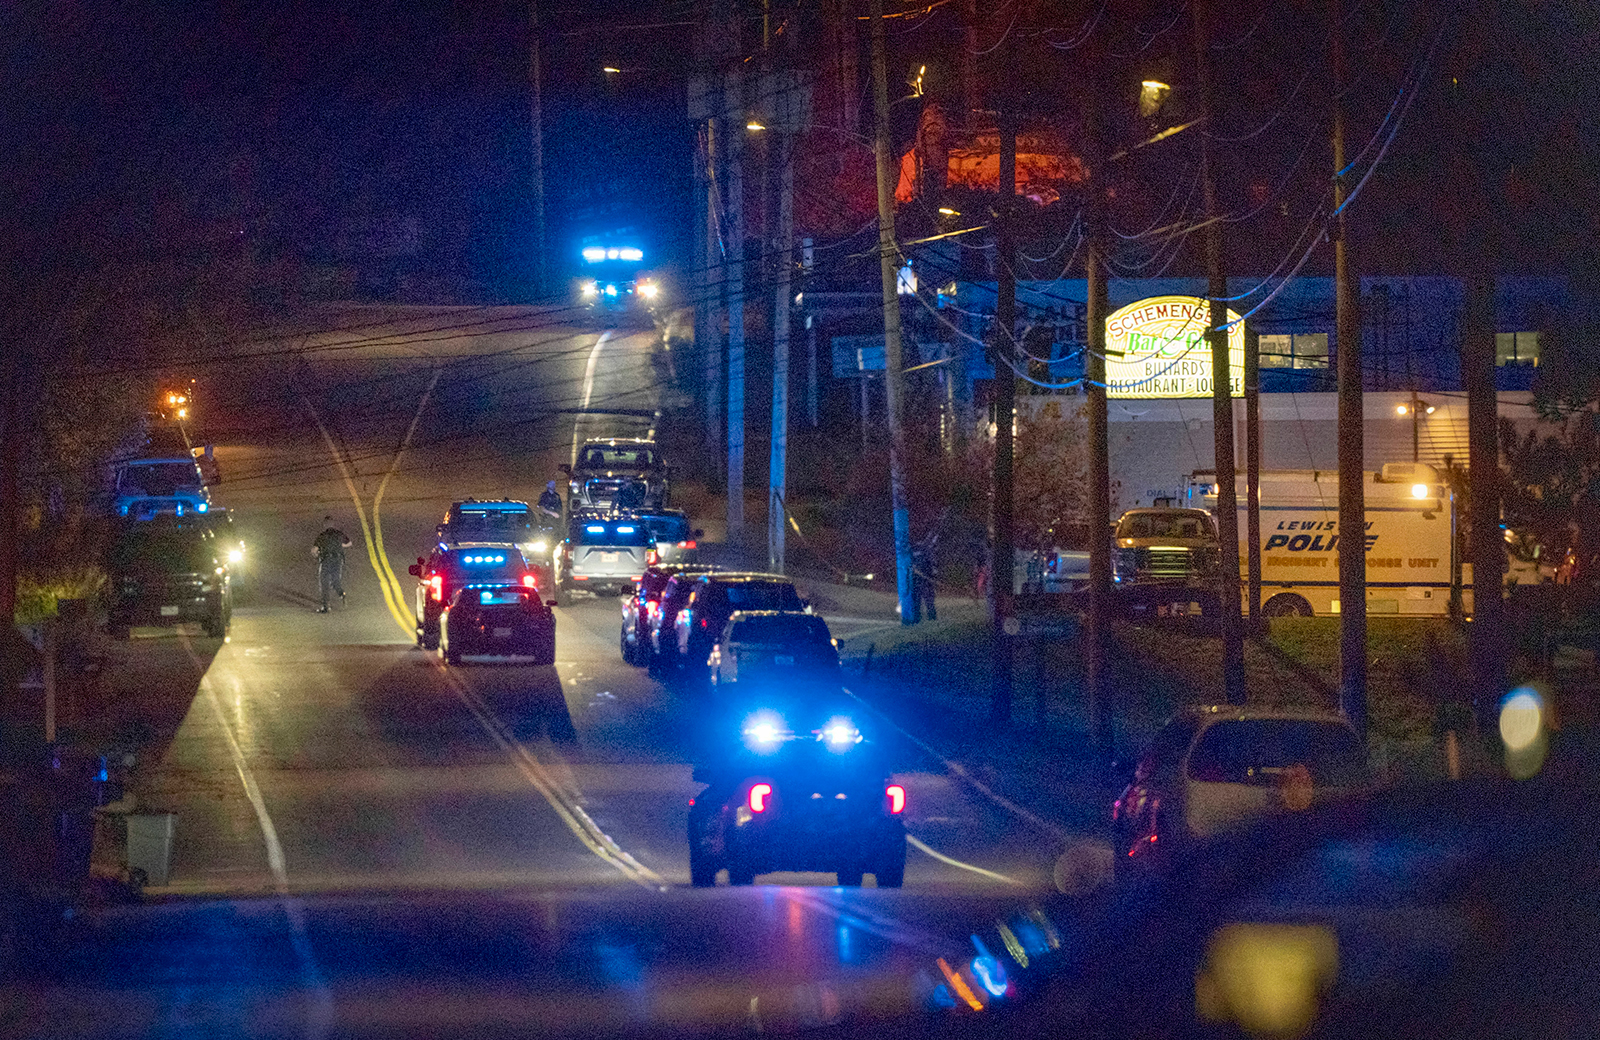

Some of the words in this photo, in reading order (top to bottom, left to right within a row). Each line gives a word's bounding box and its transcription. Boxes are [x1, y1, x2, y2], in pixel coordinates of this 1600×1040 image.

[1126, 333, 1158, 351] Bar
[1160, 326, 1186, 356] &
[1145, 361, 1205, 376] BILLIARDS
[1110, 378, 1186, 393] RESTAURANT
[1196, 378, 1240, 392] LOUGE
[1276, 521, 1375, 531] LEWISN
[1264, 534, 1380, 551] POLIE
[1408, 558, 1439, 568] UNIT
